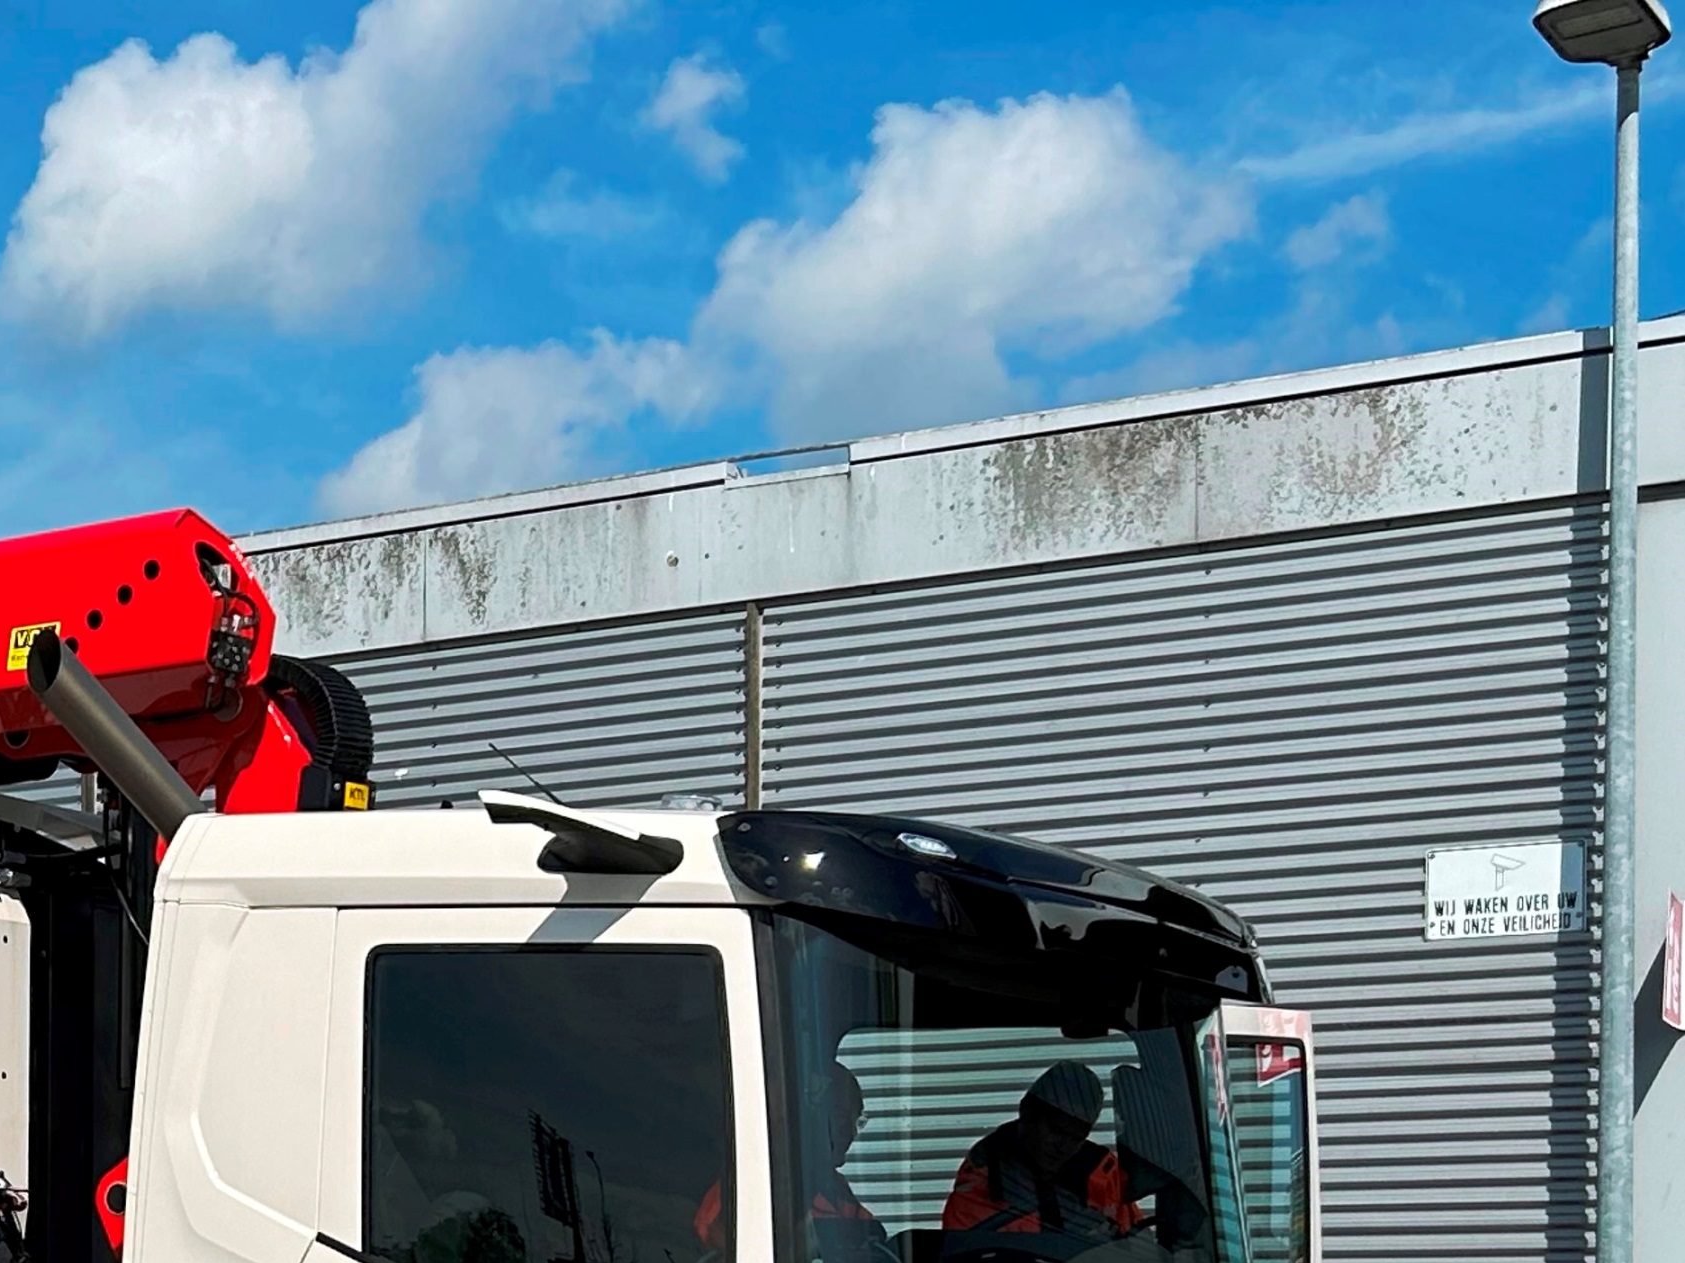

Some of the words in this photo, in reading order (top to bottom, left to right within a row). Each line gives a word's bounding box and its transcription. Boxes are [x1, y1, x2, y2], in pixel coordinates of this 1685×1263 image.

[1434, 898, 1457, 917] WIJ
[1464, 896, 1509, 915] WAKEN
[1516, 893, 1550, 911] OVER
[1557, 891, 1578, 909] UW
[1439, 919, 1455, 936] EN
[1463, 917, 1496, 934] ONZE
[1503, 912, 1572, 933] VEILIGHEID
